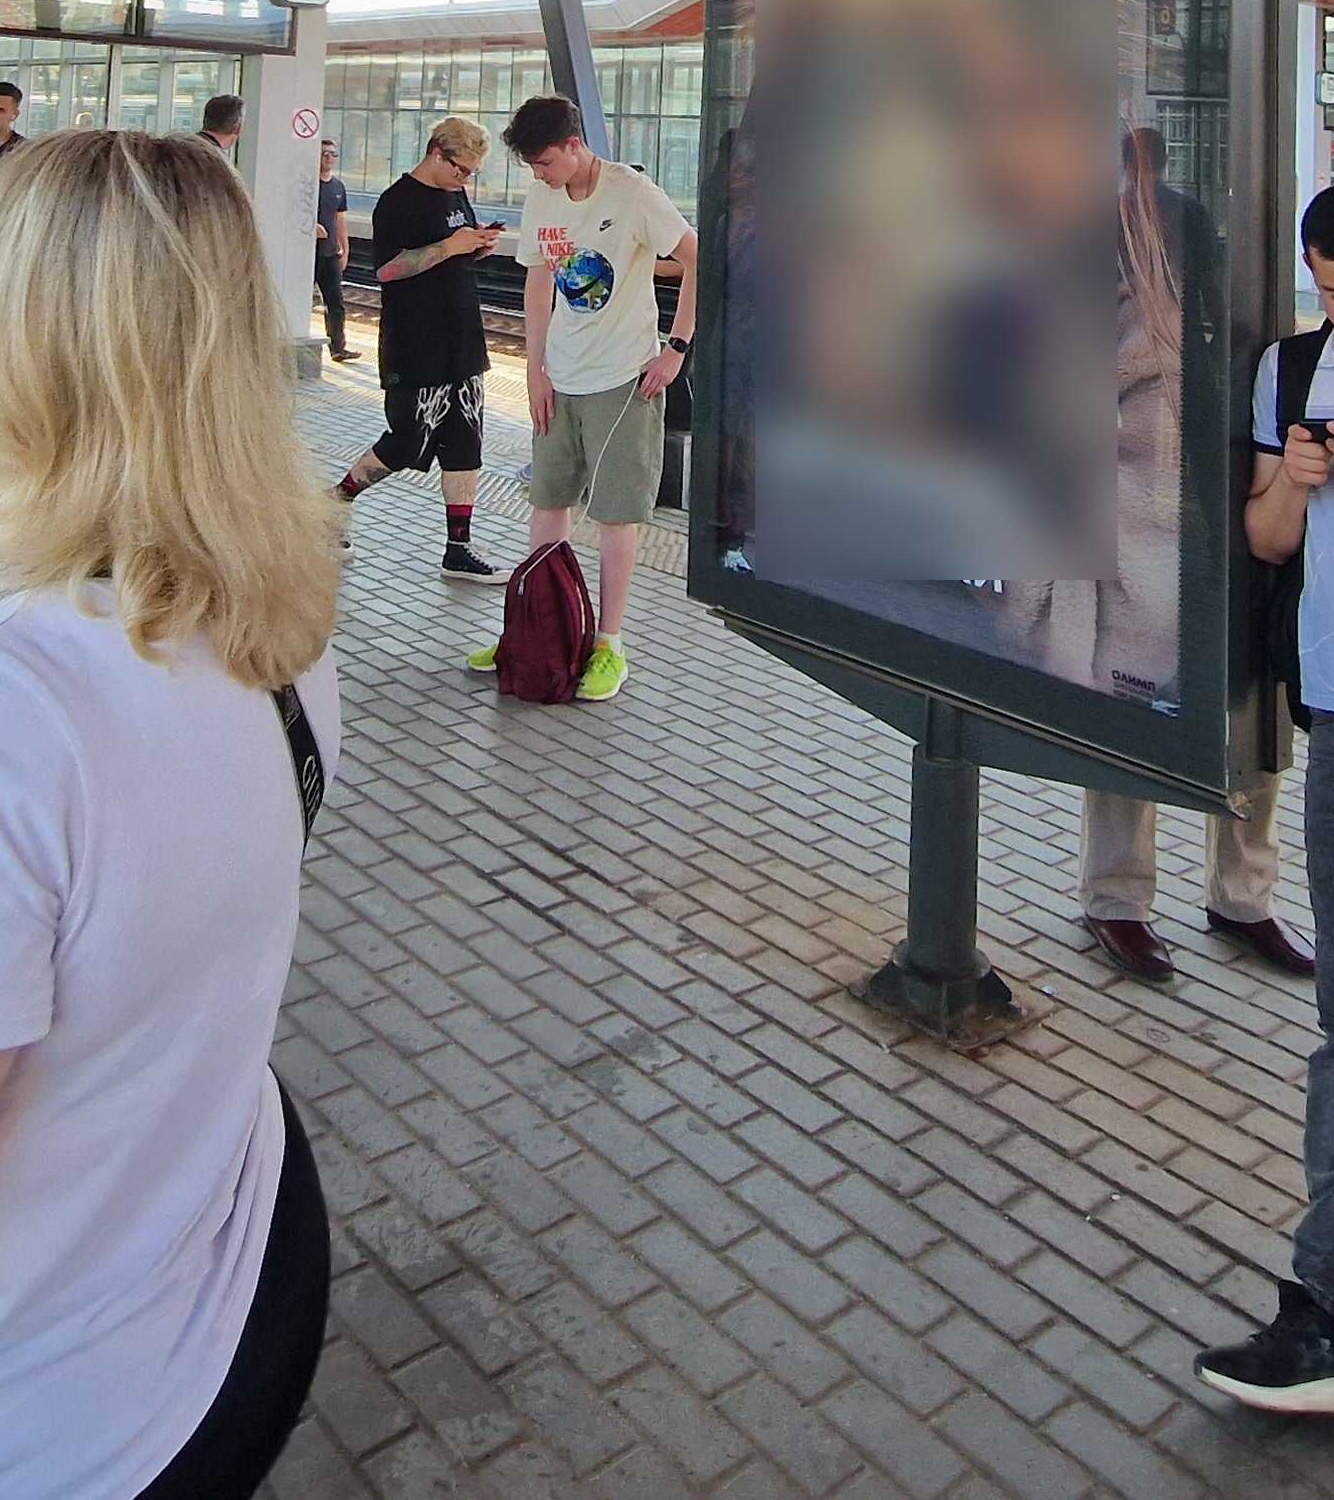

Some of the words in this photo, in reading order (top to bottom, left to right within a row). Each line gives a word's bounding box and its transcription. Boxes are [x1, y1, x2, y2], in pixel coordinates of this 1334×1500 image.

[537, 227, 568, 241] HAVE
[547, 241, 576, 256] NIKE
[1111, 669, 1156, 692] ОЛИМП
